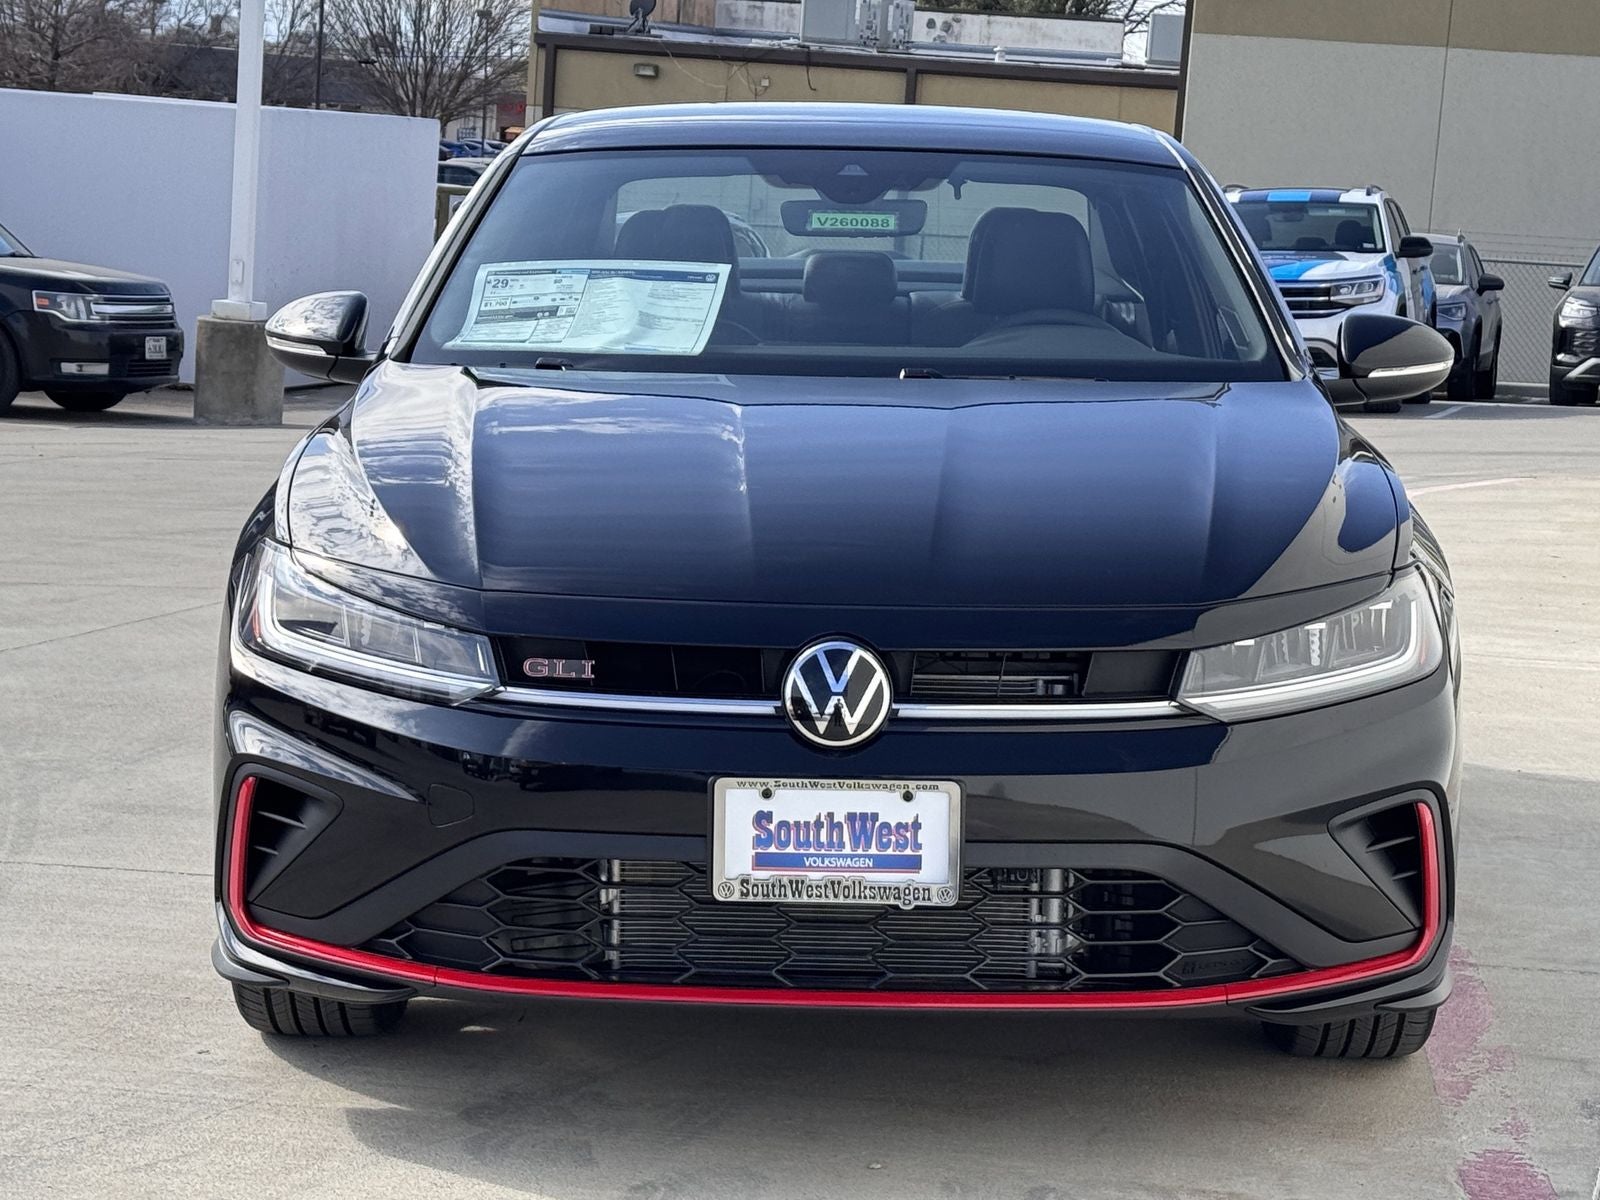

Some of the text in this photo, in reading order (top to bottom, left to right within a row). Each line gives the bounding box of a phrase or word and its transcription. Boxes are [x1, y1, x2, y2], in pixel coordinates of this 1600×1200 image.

[817, 216, 890, 228] V260088
[492, 278, 509, 289] 29
[522, 657, 596, 679] GLI
[752, 810, 923, 853] SouthWest
[803, 856, 874, 868] VOLKSWAGEN
[740, 878, 932, 906] SouthWestVolkswagen
